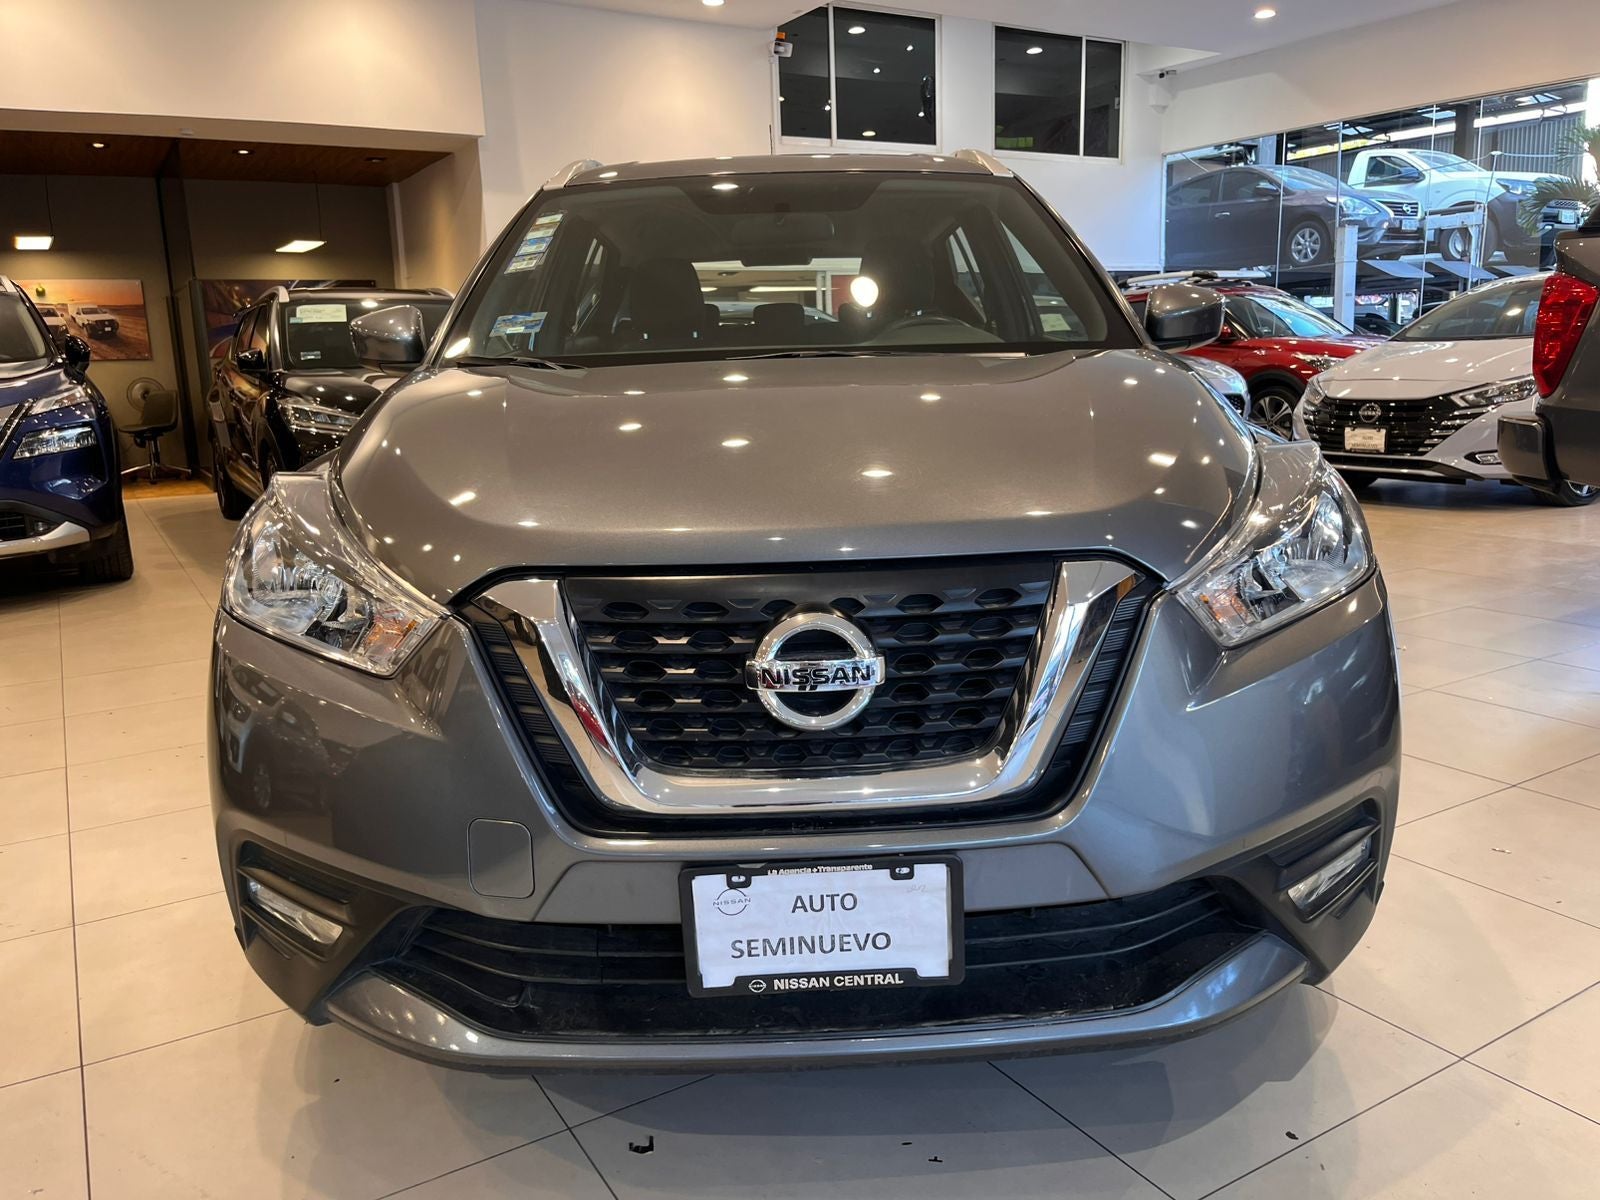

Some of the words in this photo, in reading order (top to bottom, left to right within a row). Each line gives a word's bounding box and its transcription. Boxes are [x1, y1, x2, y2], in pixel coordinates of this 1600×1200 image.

[760, 665, 871, 687] NISSAN
[712, 897, 752, 907] NISSAN
[791, 892, 858, 914] AUTO
[730, 932, 892, 959] SEMINUEVO
[773, 976, 830, 991] NISSAN
[833, 972, 904, 987] CENTRAL
